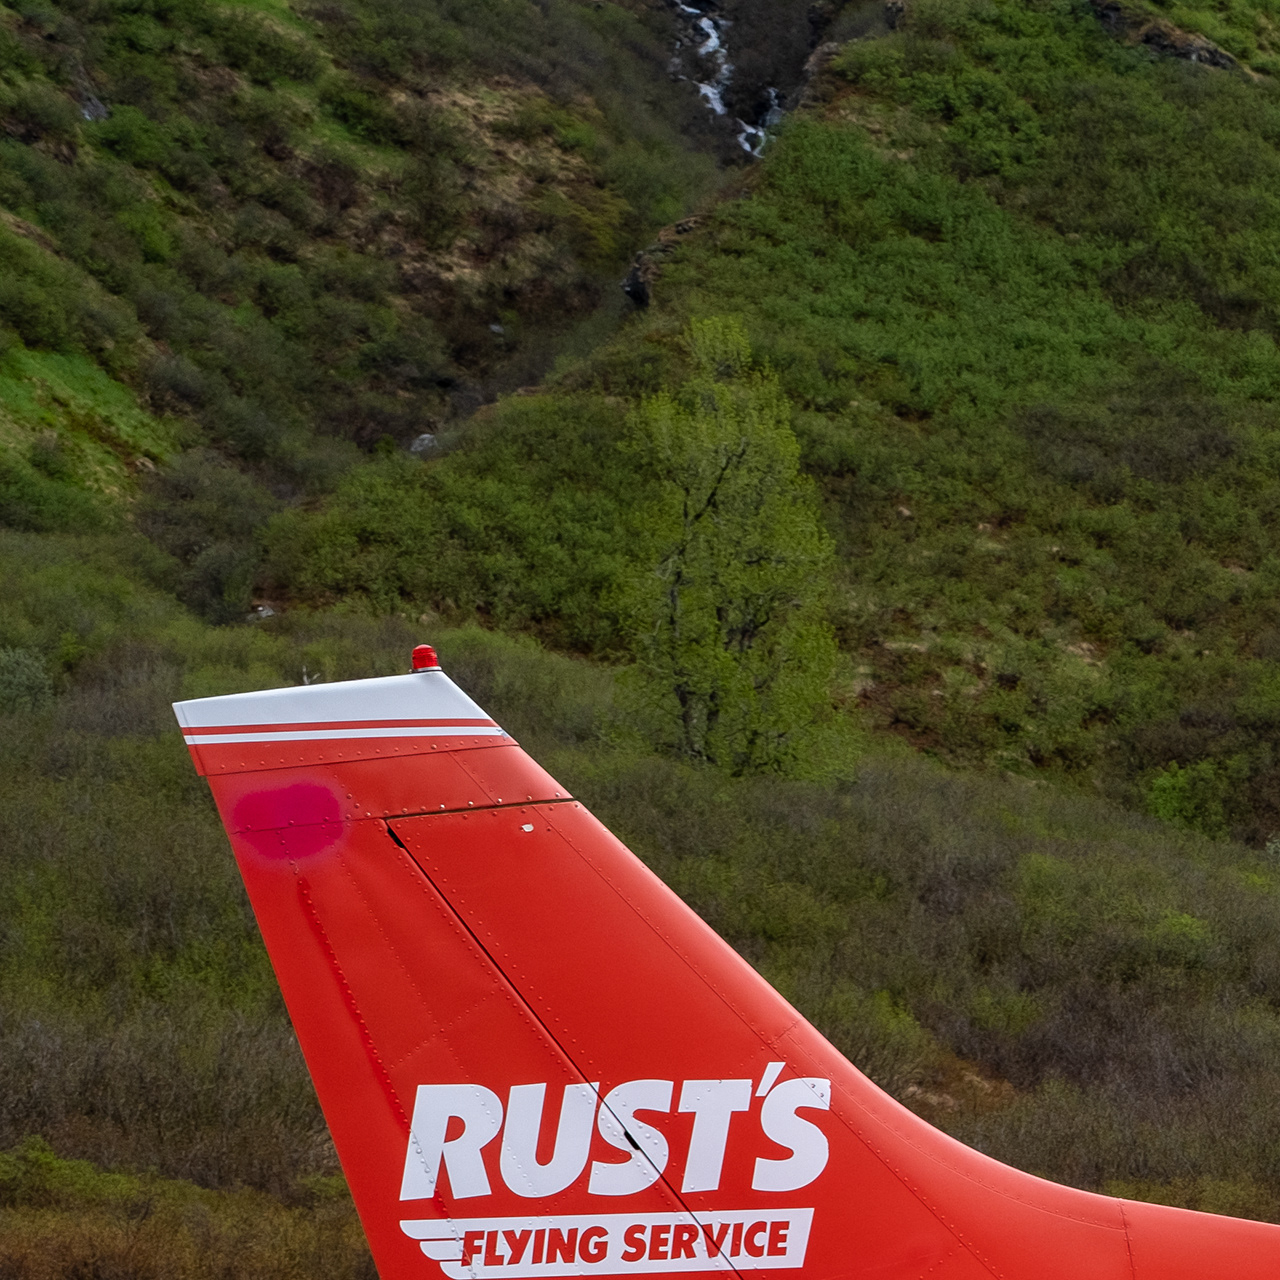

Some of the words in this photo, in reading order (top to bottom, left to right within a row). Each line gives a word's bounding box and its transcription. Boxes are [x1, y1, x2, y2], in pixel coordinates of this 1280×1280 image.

[400, 1062, 831, 1201] RUST'S
[460, 1224, 609, 1267] FLYING
[620, 1220, 790, 1261] SERVICE
